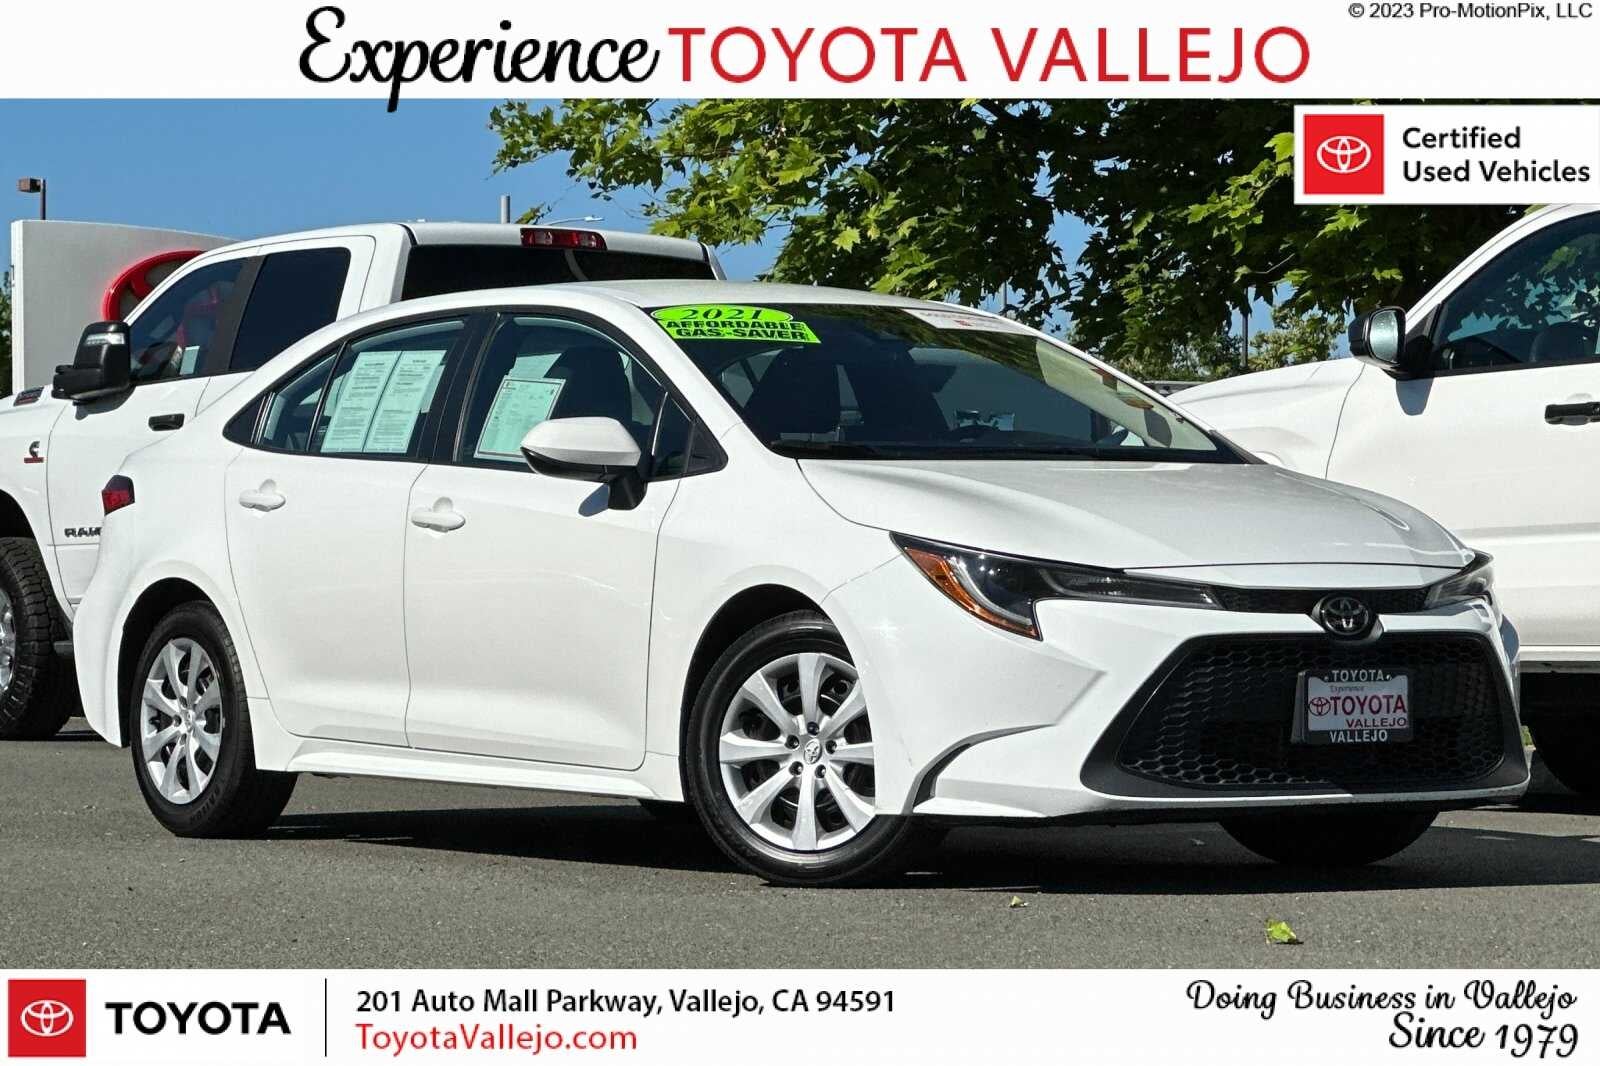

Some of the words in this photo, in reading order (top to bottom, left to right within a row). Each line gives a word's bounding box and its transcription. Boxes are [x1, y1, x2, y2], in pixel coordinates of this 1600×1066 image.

[680, 307, 764, 320] 2021
[666, 320, 803, 332] AFFORDABLE
[675, 328, 806, 341] GAS-SAVER
[64, 526, 102, 538] RAM
[1331, 669, 1385, 682] TOYOTA
[1329, 694, 1407, 716] TOYOTA
[1345, 717, 1408, 729] VALLEJO
[1329, 729, 1388, 743] VALLEJO
